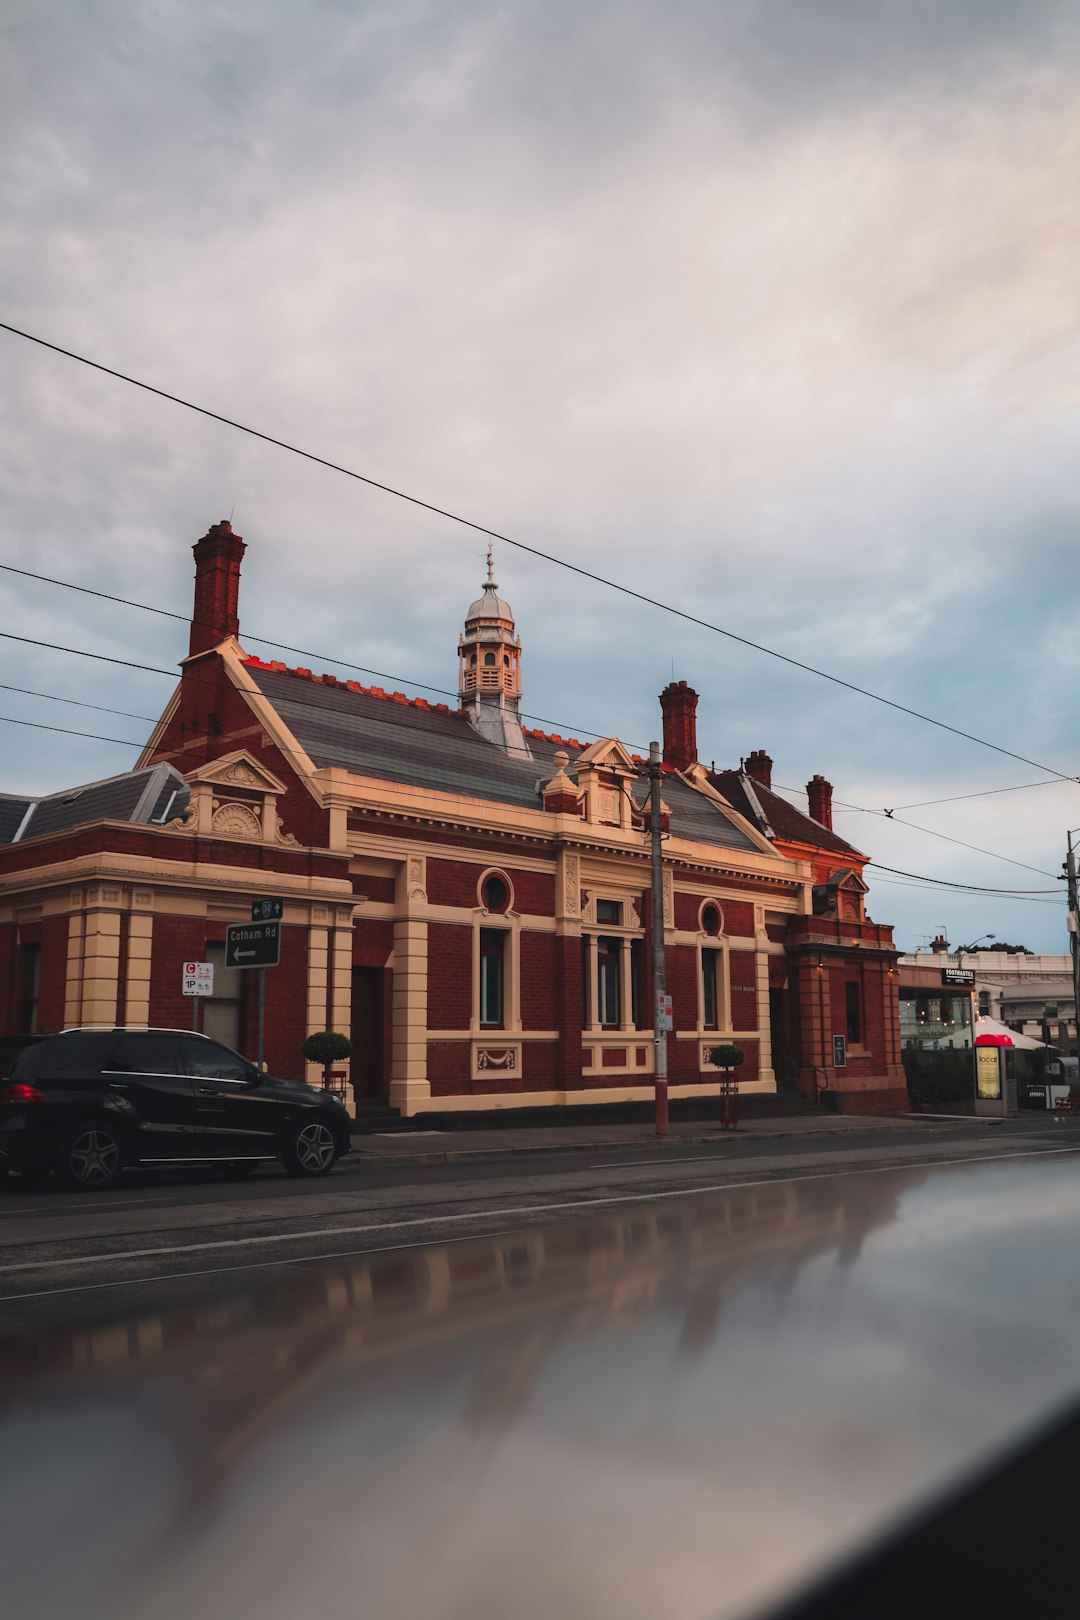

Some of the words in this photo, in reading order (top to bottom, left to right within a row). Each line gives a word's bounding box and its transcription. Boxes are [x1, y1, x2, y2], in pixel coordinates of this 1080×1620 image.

[231, 930, 262, 941] Cotham
[265, 926, 276, 938] Rd
[187, 964, 195, 973] C
